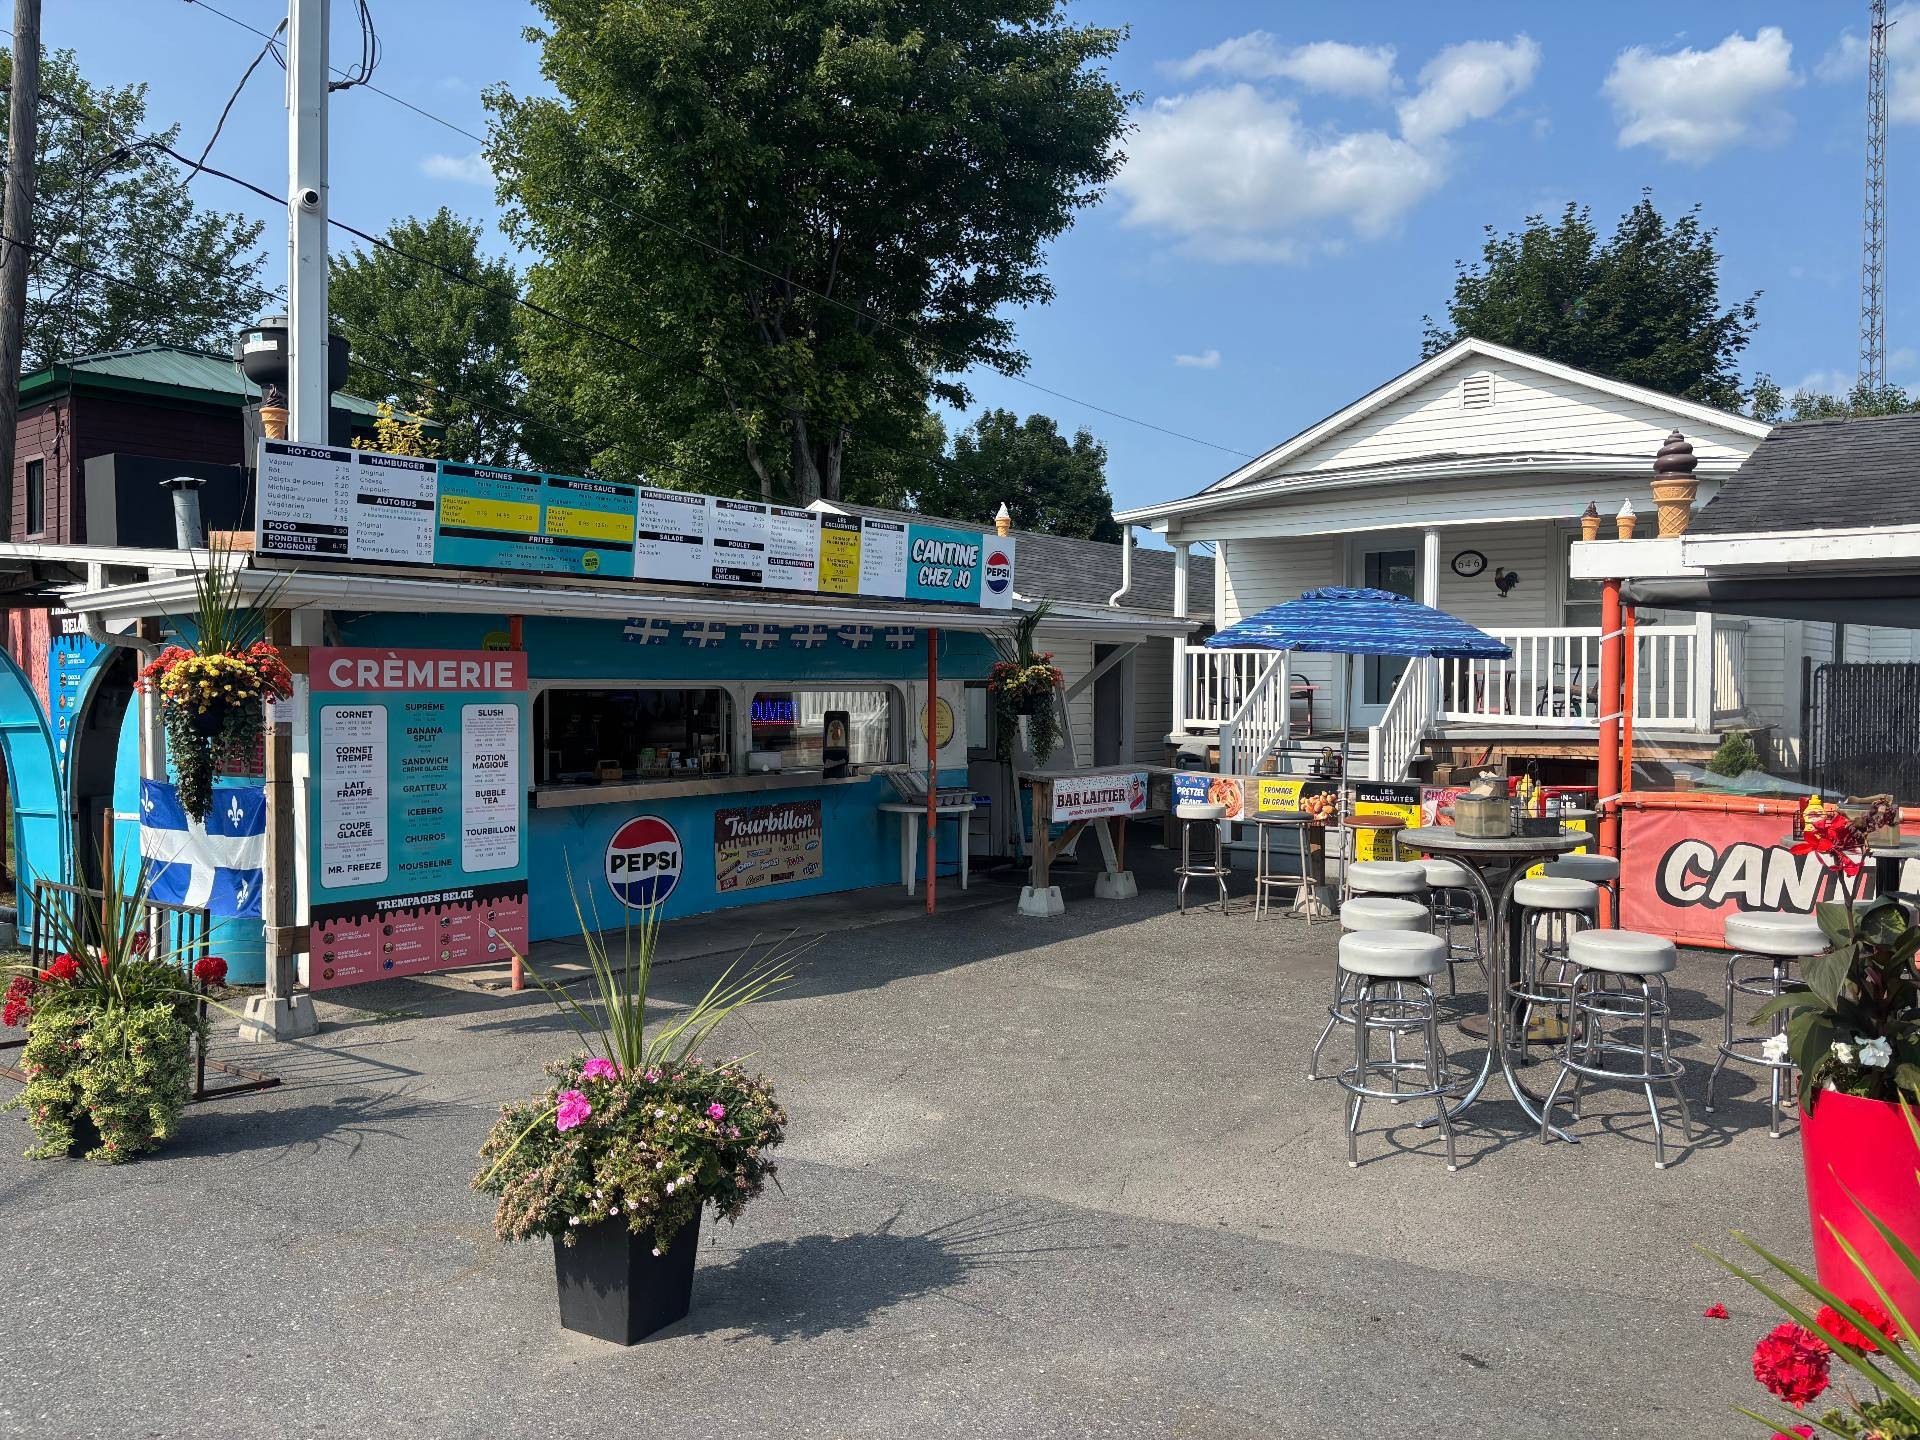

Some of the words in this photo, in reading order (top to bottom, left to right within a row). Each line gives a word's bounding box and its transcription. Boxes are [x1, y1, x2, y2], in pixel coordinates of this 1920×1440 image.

[288, 447, 331, 458] HOT-DOG
[372, 458, 424, 470] HAMBURGER
[474, 470, 512, 480] POUTINES
[568, 482, 592, 490] FRITES
[594, 484, 616, 494] SAUCE
[376, 498, 416, 508] AUTOBUS
[644, 492, 682, 502] HAMBURGER
[684, 496, 702, 504] STEAK
[726, 502, 757, 512] SPAGHETTI
[780, 510, 808, 518] SANDWICH
[268, 522, 296, 530] POGO
[872, 522, 898, 530] BREUVAGES
[268, 534, 318, 544] RONDELLES
[528, 536, 554, 544] FRITES
[660, 534, 684, 542] SALADE
[268, 542, 316, 551] D'OIGNONS
[913, 538, 978, 566] CANTINE
[784, 560, 812, 568] SANDWICH
[920, 566, 952, 586] CHEZ
[954, 570, 970, 588] JO
[986, 567, 1010, 578] PEPSI
[328, 652, 512, 688] CRÈMERIE
[405, 702, 445, 710] SUPRÊME
[750, 702, 799, 721] OUVERT
[414, 734, 436, 742] SPLIT
[336, 746, 373, 754] CORNET
[402, 757, 448, 766] SANDWICH
[476, 754, 506, 762] POTION
[472, 760, 508, 770] MAGIQUE
[337, 786, 372, 798] FRAPPÉ
[402, 784, 448, 792] GRATTEUX
[1176, 786, 1204, 796] PRETZEL
[476, 789, 506, 798] BUBBLE
[1056, 792, 1080, 808] BAR
[1082, 789, 1125, 804] LAITIER
[1361, 792, 1414, 802] EXCLUSIVITÉS
[1180, 796, 1203, 805] GÉANT
[408, 807, 444, 816] ICEBERG
[340, 822, 370, 830] COUPE
[724, 810, 814, 836] Tourbillon
[338, 828, 372, 838] GLACÉE
[466, 826, 516, 836] TOURBILLON
[405, 832, 446, 844] CHURROS
[398, 858, 452, 871] MOUSSELINE
[610, 851, 677, 874] PEPSI
[328, 866, 344, 874] MR.
[348, 862, 382, 872] FREEZE
[377, 894, 440, 910] TREMPAGES
[442, 890, 474, 902] BELGE
